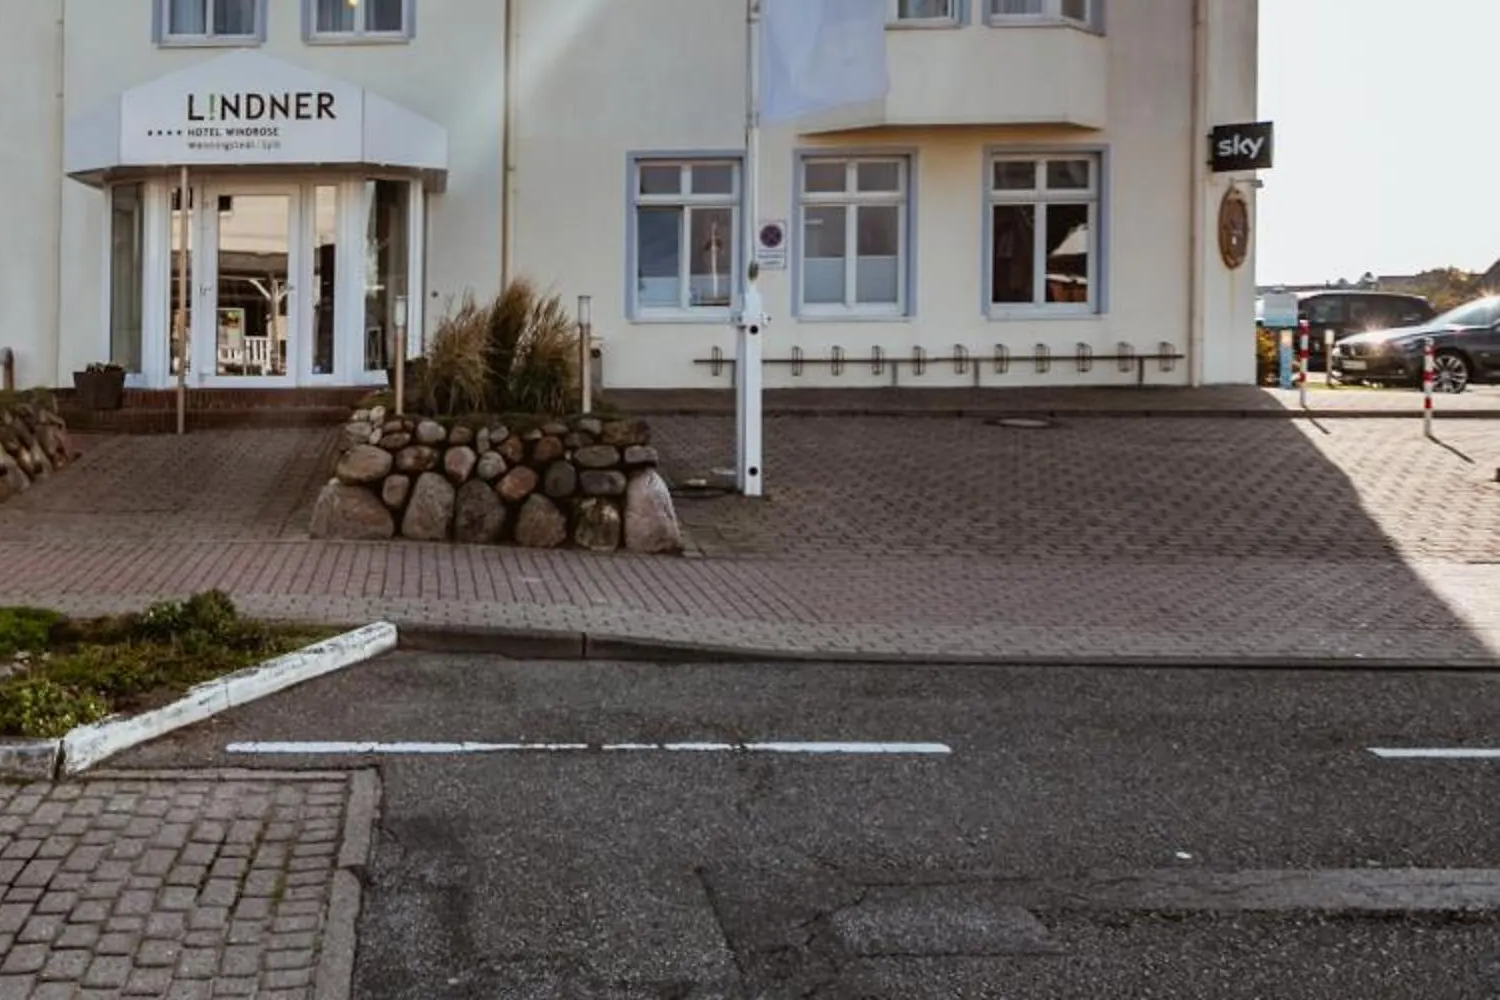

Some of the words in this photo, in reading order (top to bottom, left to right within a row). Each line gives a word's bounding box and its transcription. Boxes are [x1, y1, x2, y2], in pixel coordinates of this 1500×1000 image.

[187, 127, 221, 137] HOTEL
[225, 126, 280, 137] WINDROSE
[1217, 133, 1264, 159] sky
